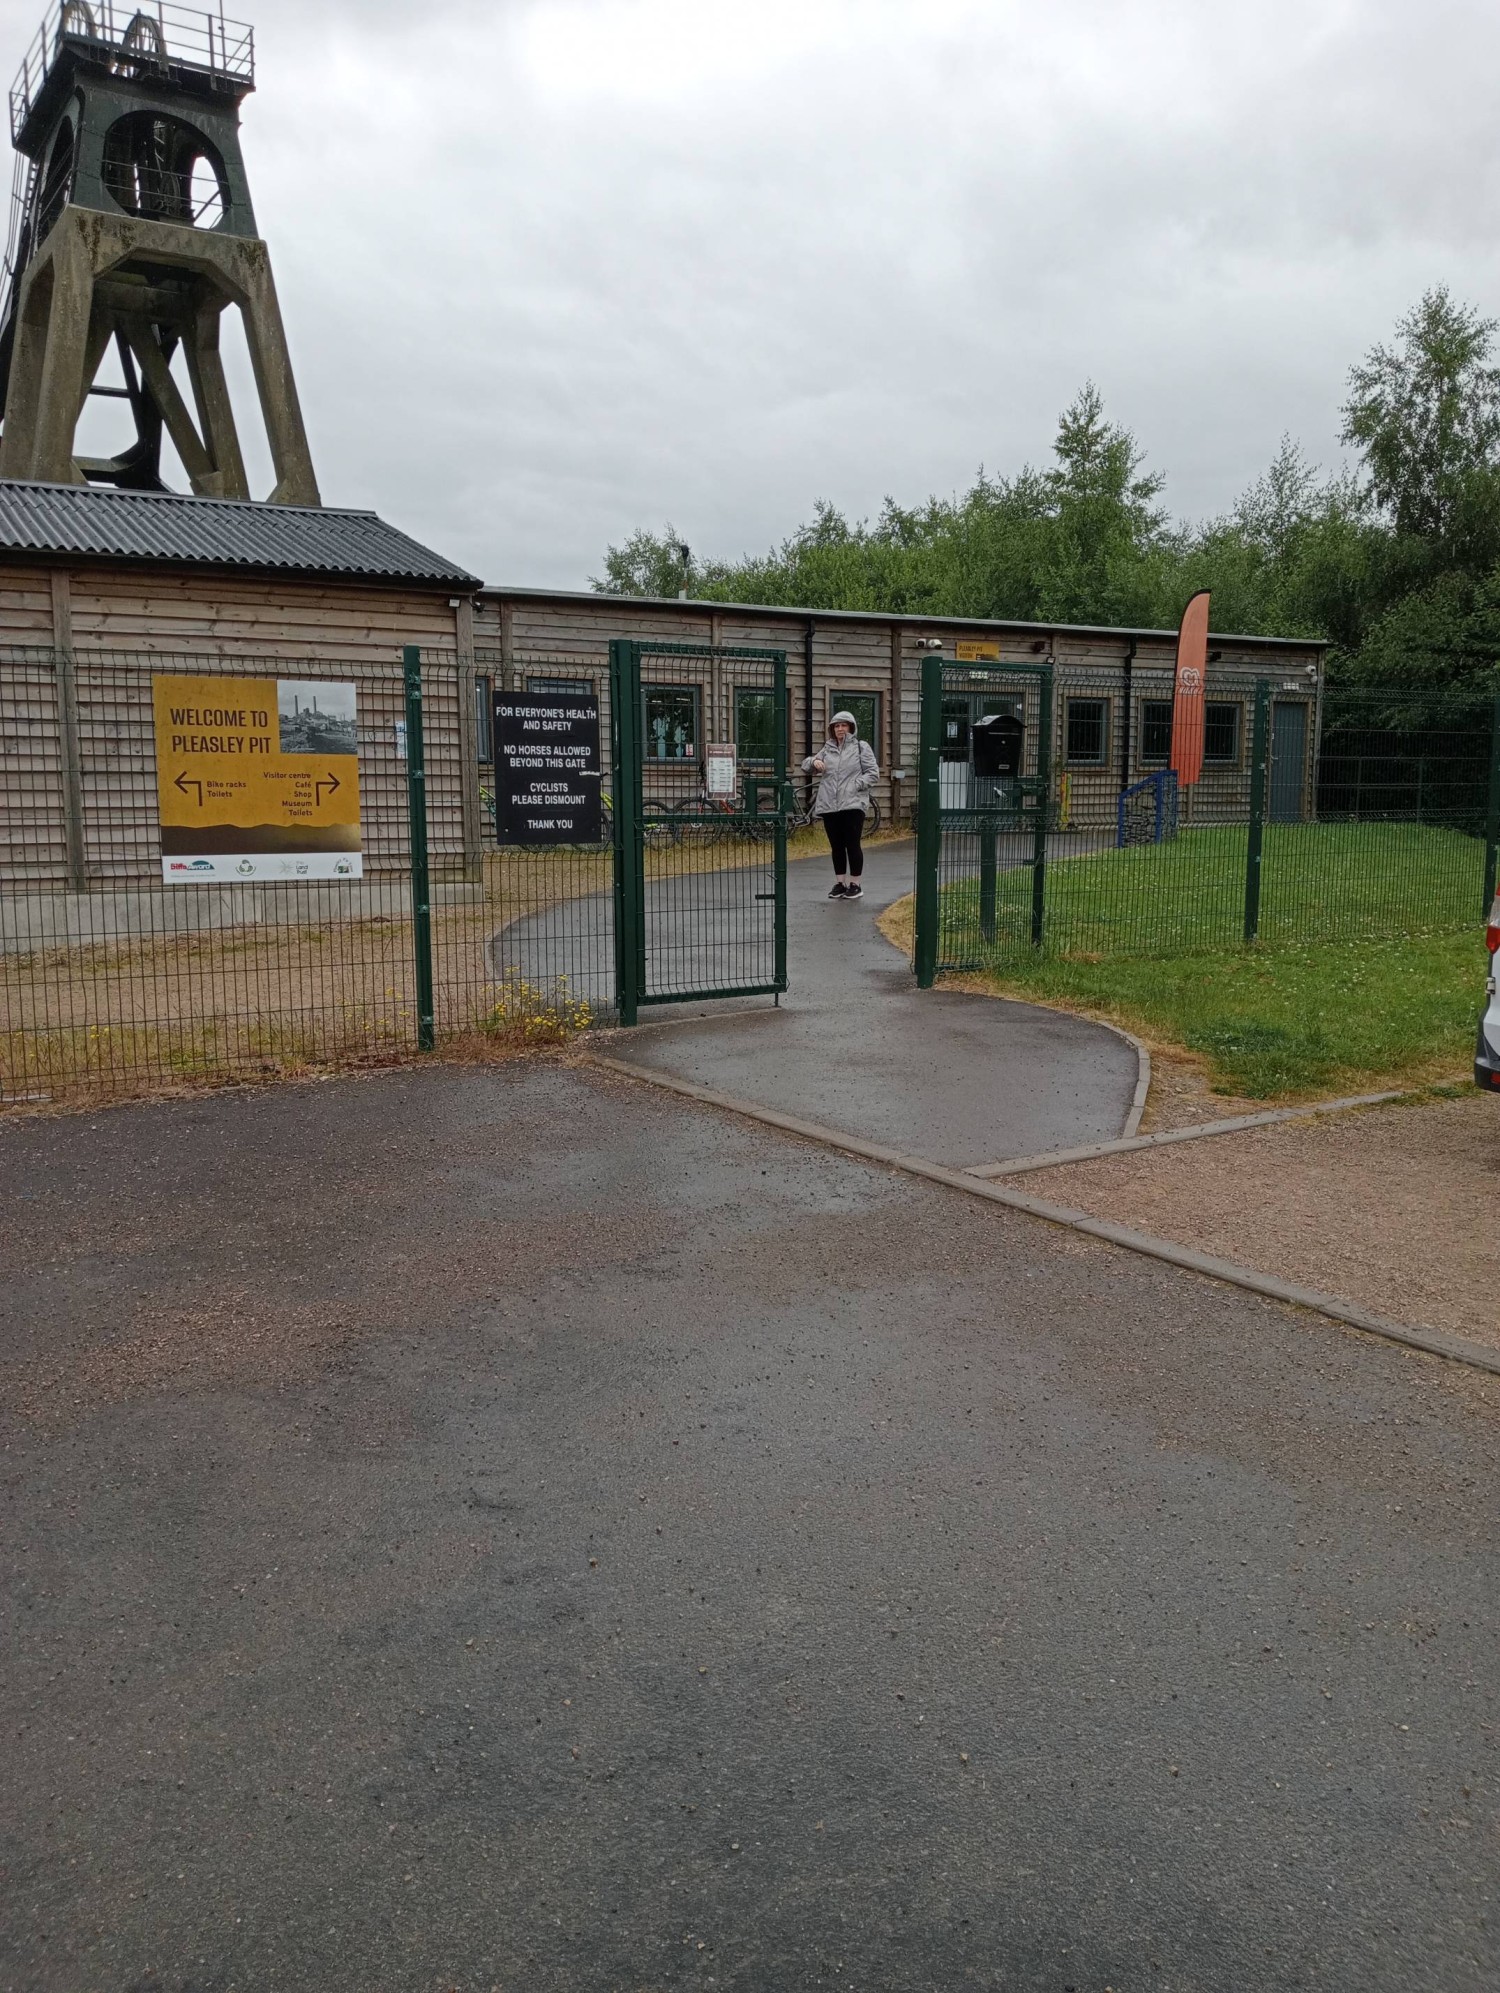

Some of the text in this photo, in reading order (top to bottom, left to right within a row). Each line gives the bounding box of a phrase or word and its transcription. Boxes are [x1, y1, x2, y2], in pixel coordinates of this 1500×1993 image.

[496, 706, 597, 719] FOR EVERYONE'S HEALTH
[169, 708, 268, 728] WELCOME TO
[523, 721, 572, 730] AND SAFETY
[172, 735, 271, 753] PLEASLEY PIT
[504, 745, 591, 755] NO HORSES ALLOWED
[510, 758, 586, 768] BEYOND THIS GATE
[530, 783, 568, 792] CYCLISTS
[512, 795, 586, 804] PLEASE DISMOUNT
[527, 819, 573, 829] THANK YOU
